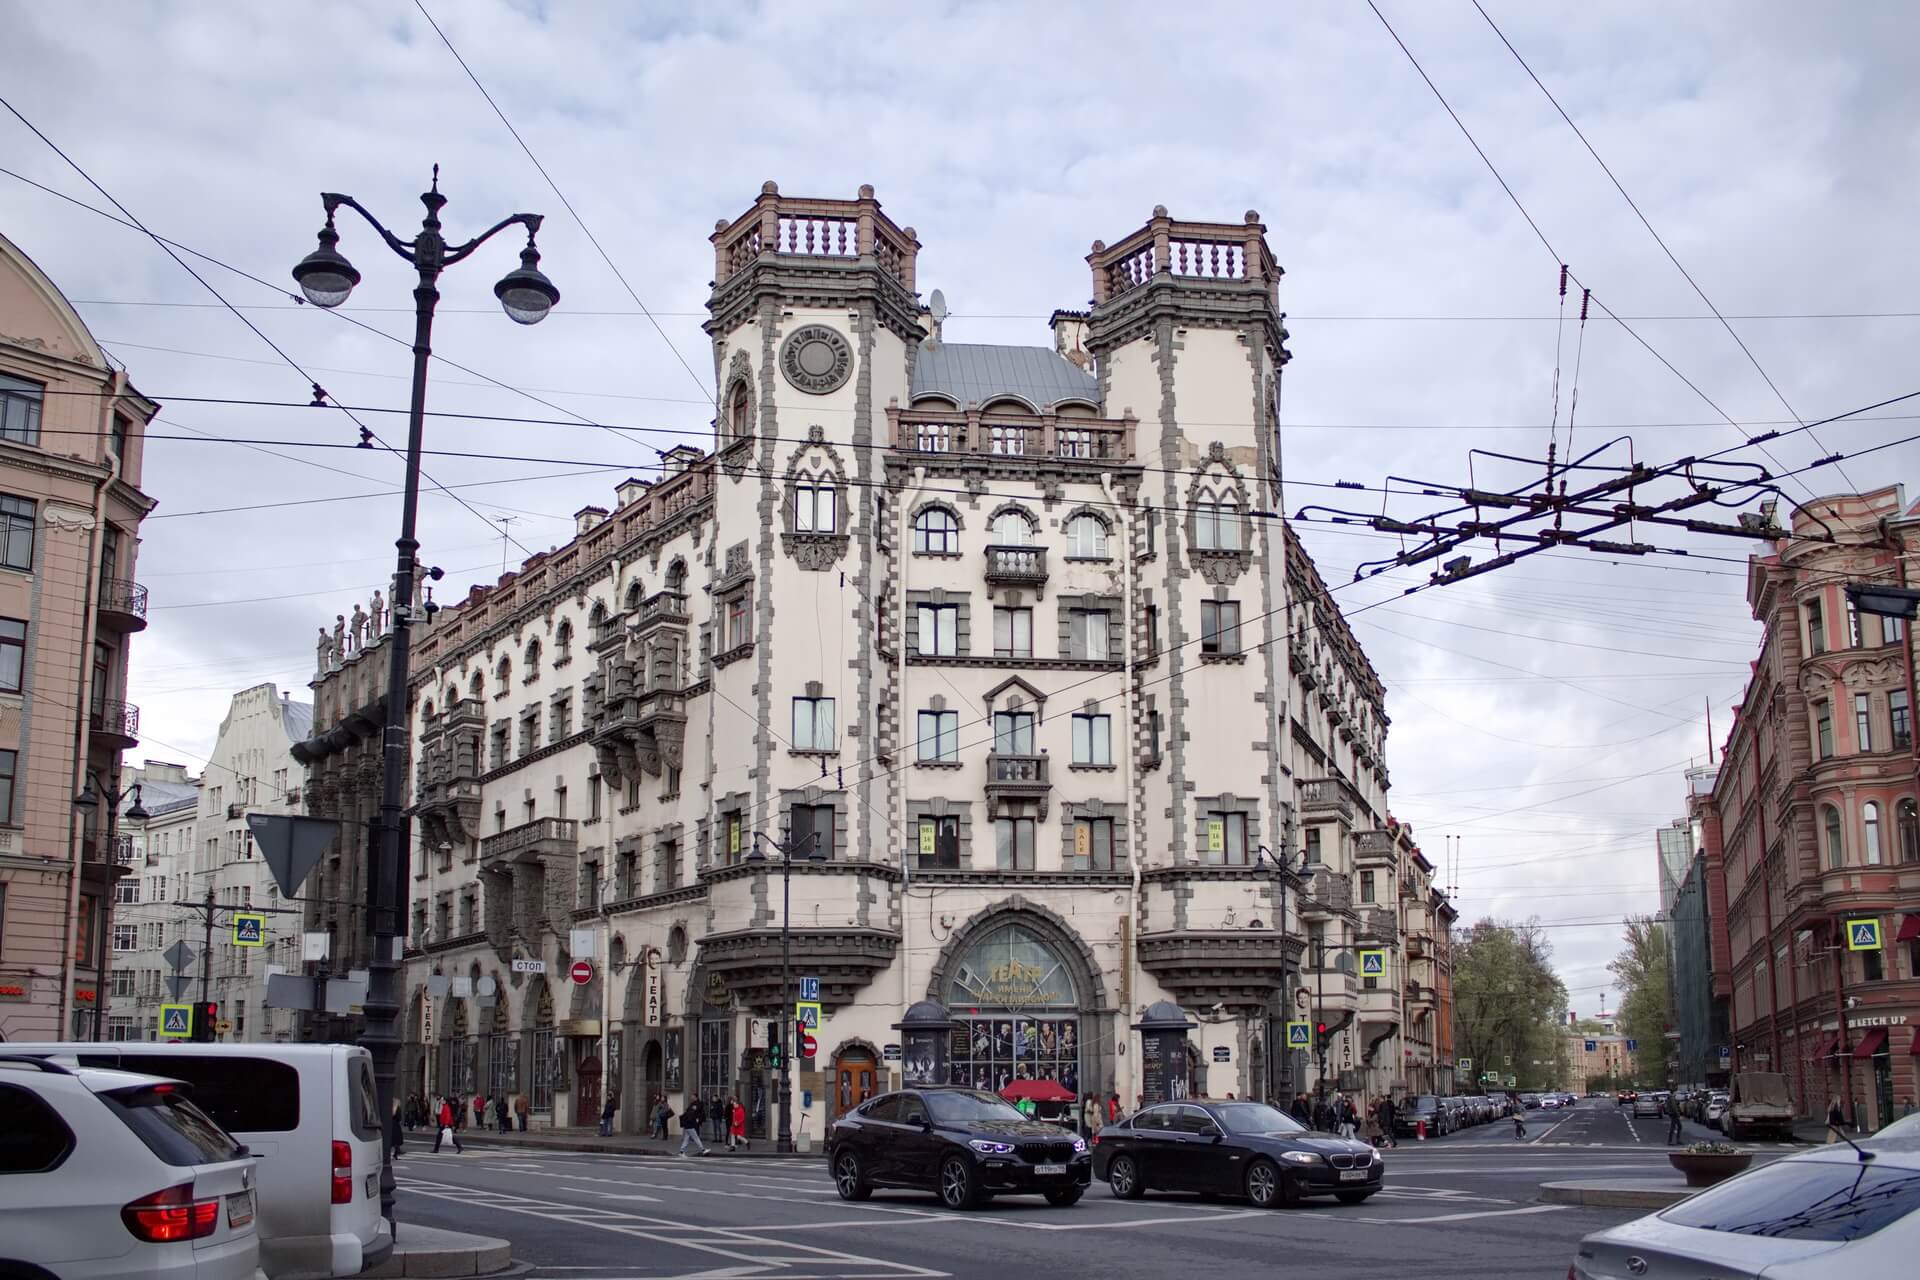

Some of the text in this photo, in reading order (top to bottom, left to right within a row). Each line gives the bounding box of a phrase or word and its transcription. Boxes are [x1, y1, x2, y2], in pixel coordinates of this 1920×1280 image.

[516, 961, 542, 971] СТОП
[649, 975, 657, 1024] ТЕАТР
[424, 1005, 432, 1042] ТЕАТР
[1343, 1028, 1351, 1069] ТЕАТР
